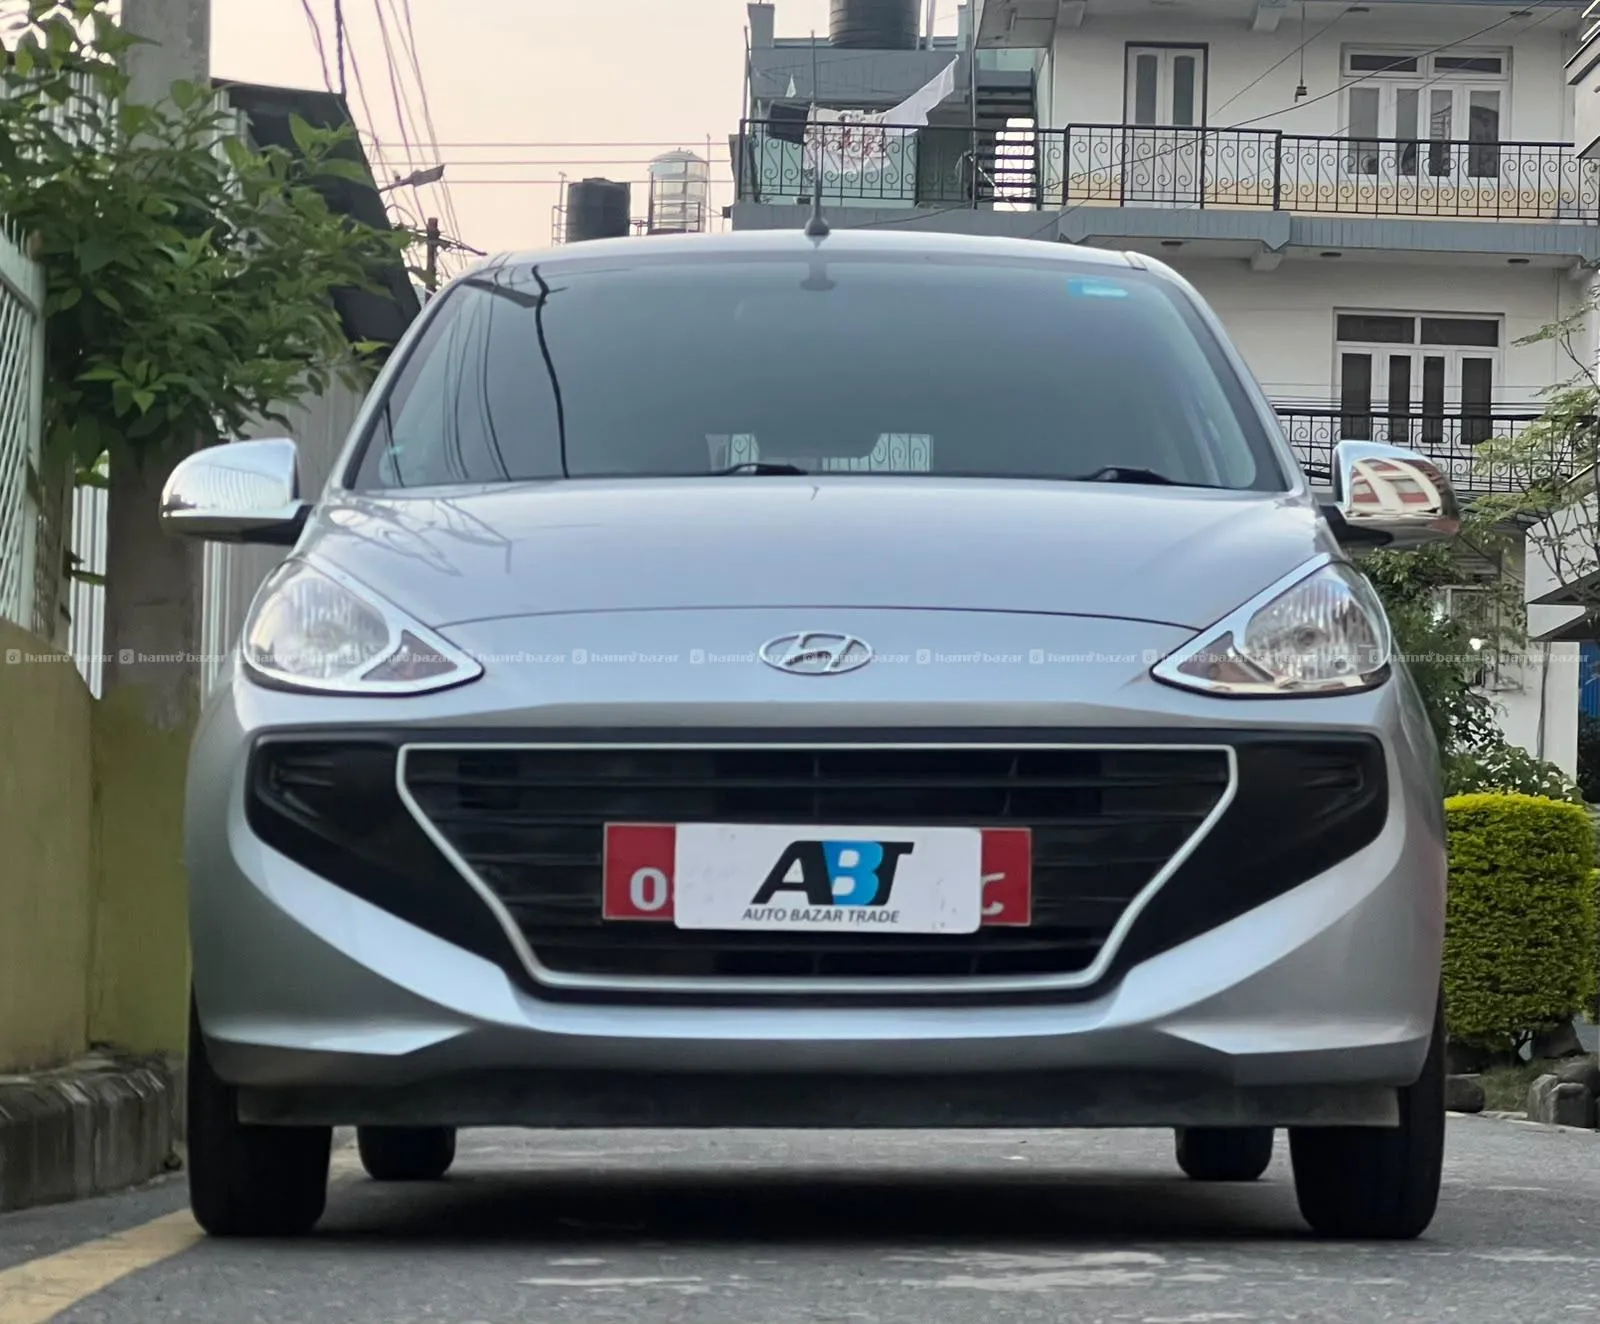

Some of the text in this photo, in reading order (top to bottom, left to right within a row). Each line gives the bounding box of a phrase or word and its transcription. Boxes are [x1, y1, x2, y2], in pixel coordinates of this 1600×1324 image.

[750, 840, 914, 907] ABT
[743, 908, 900, 923] AUTO BAZAR TRADE
